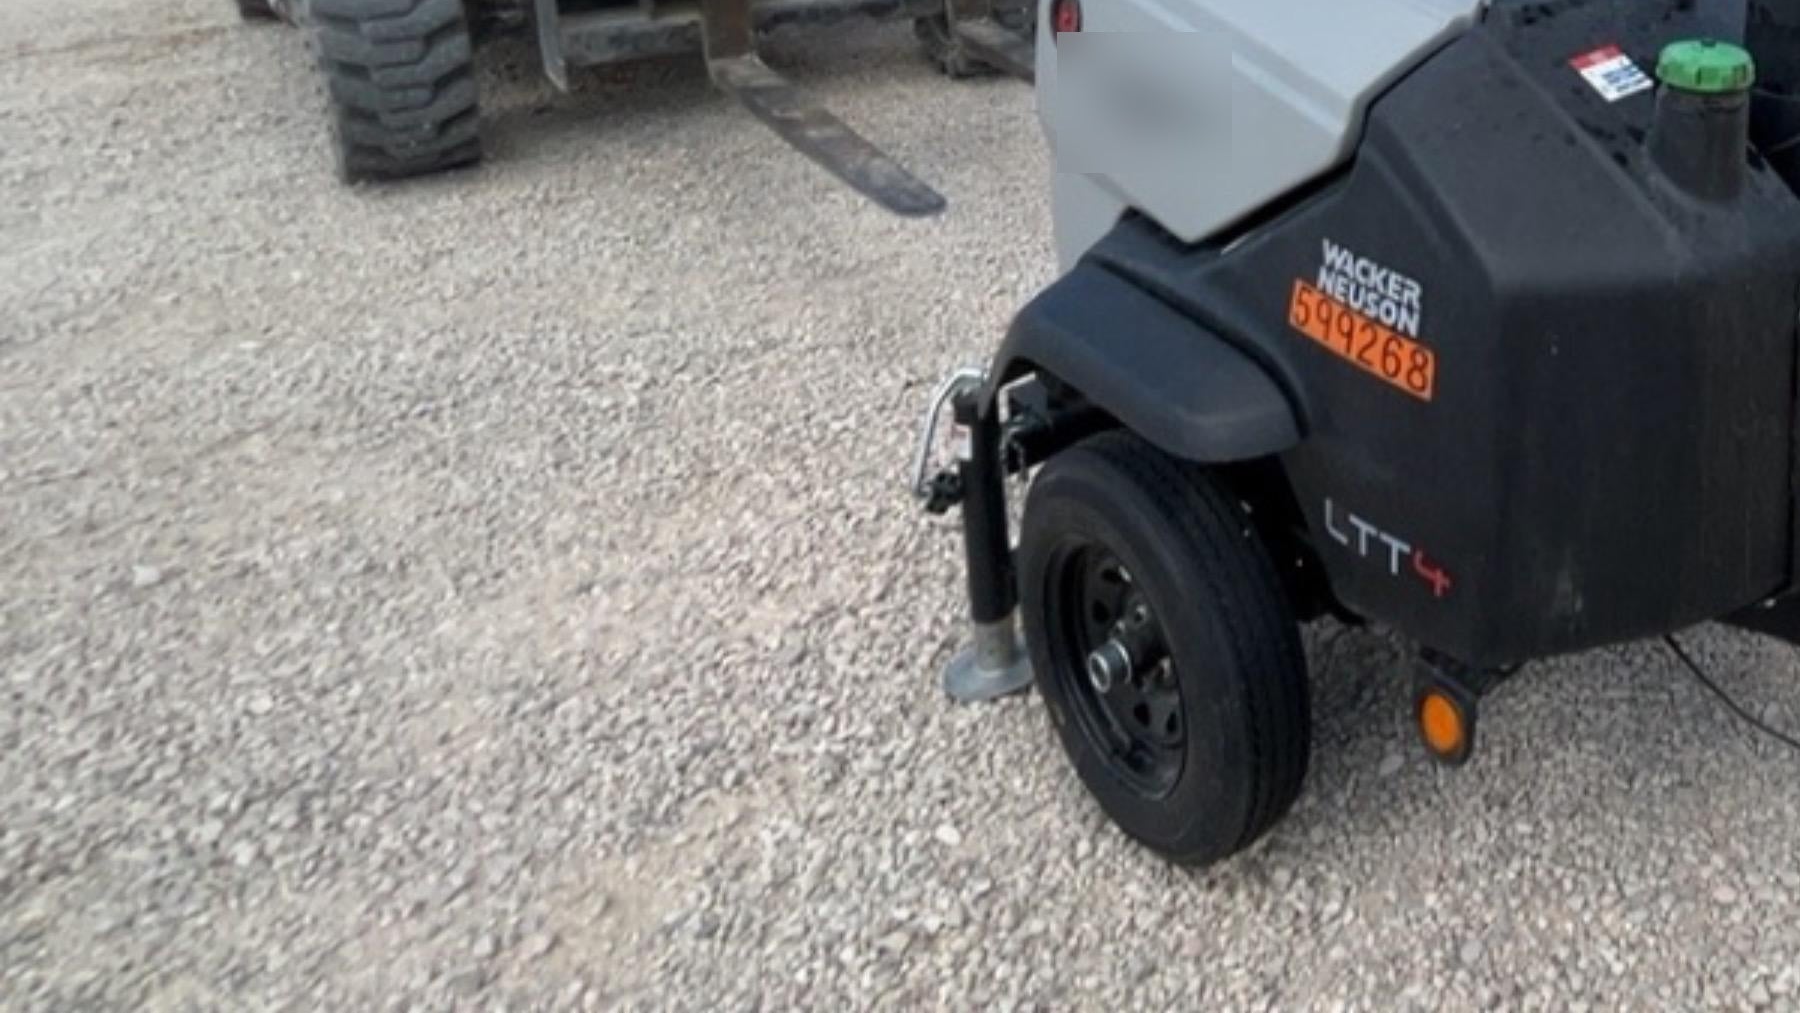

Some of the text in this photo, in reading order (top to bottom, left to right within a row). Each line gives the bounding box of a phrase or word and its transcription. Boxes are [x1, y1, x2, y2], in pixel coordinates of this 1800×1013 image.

[1316, 266, 1422, 338] NEUSON
[1322, 237, 1422, 309] WACKER
[1294, 287, 1430, 393] 599268
